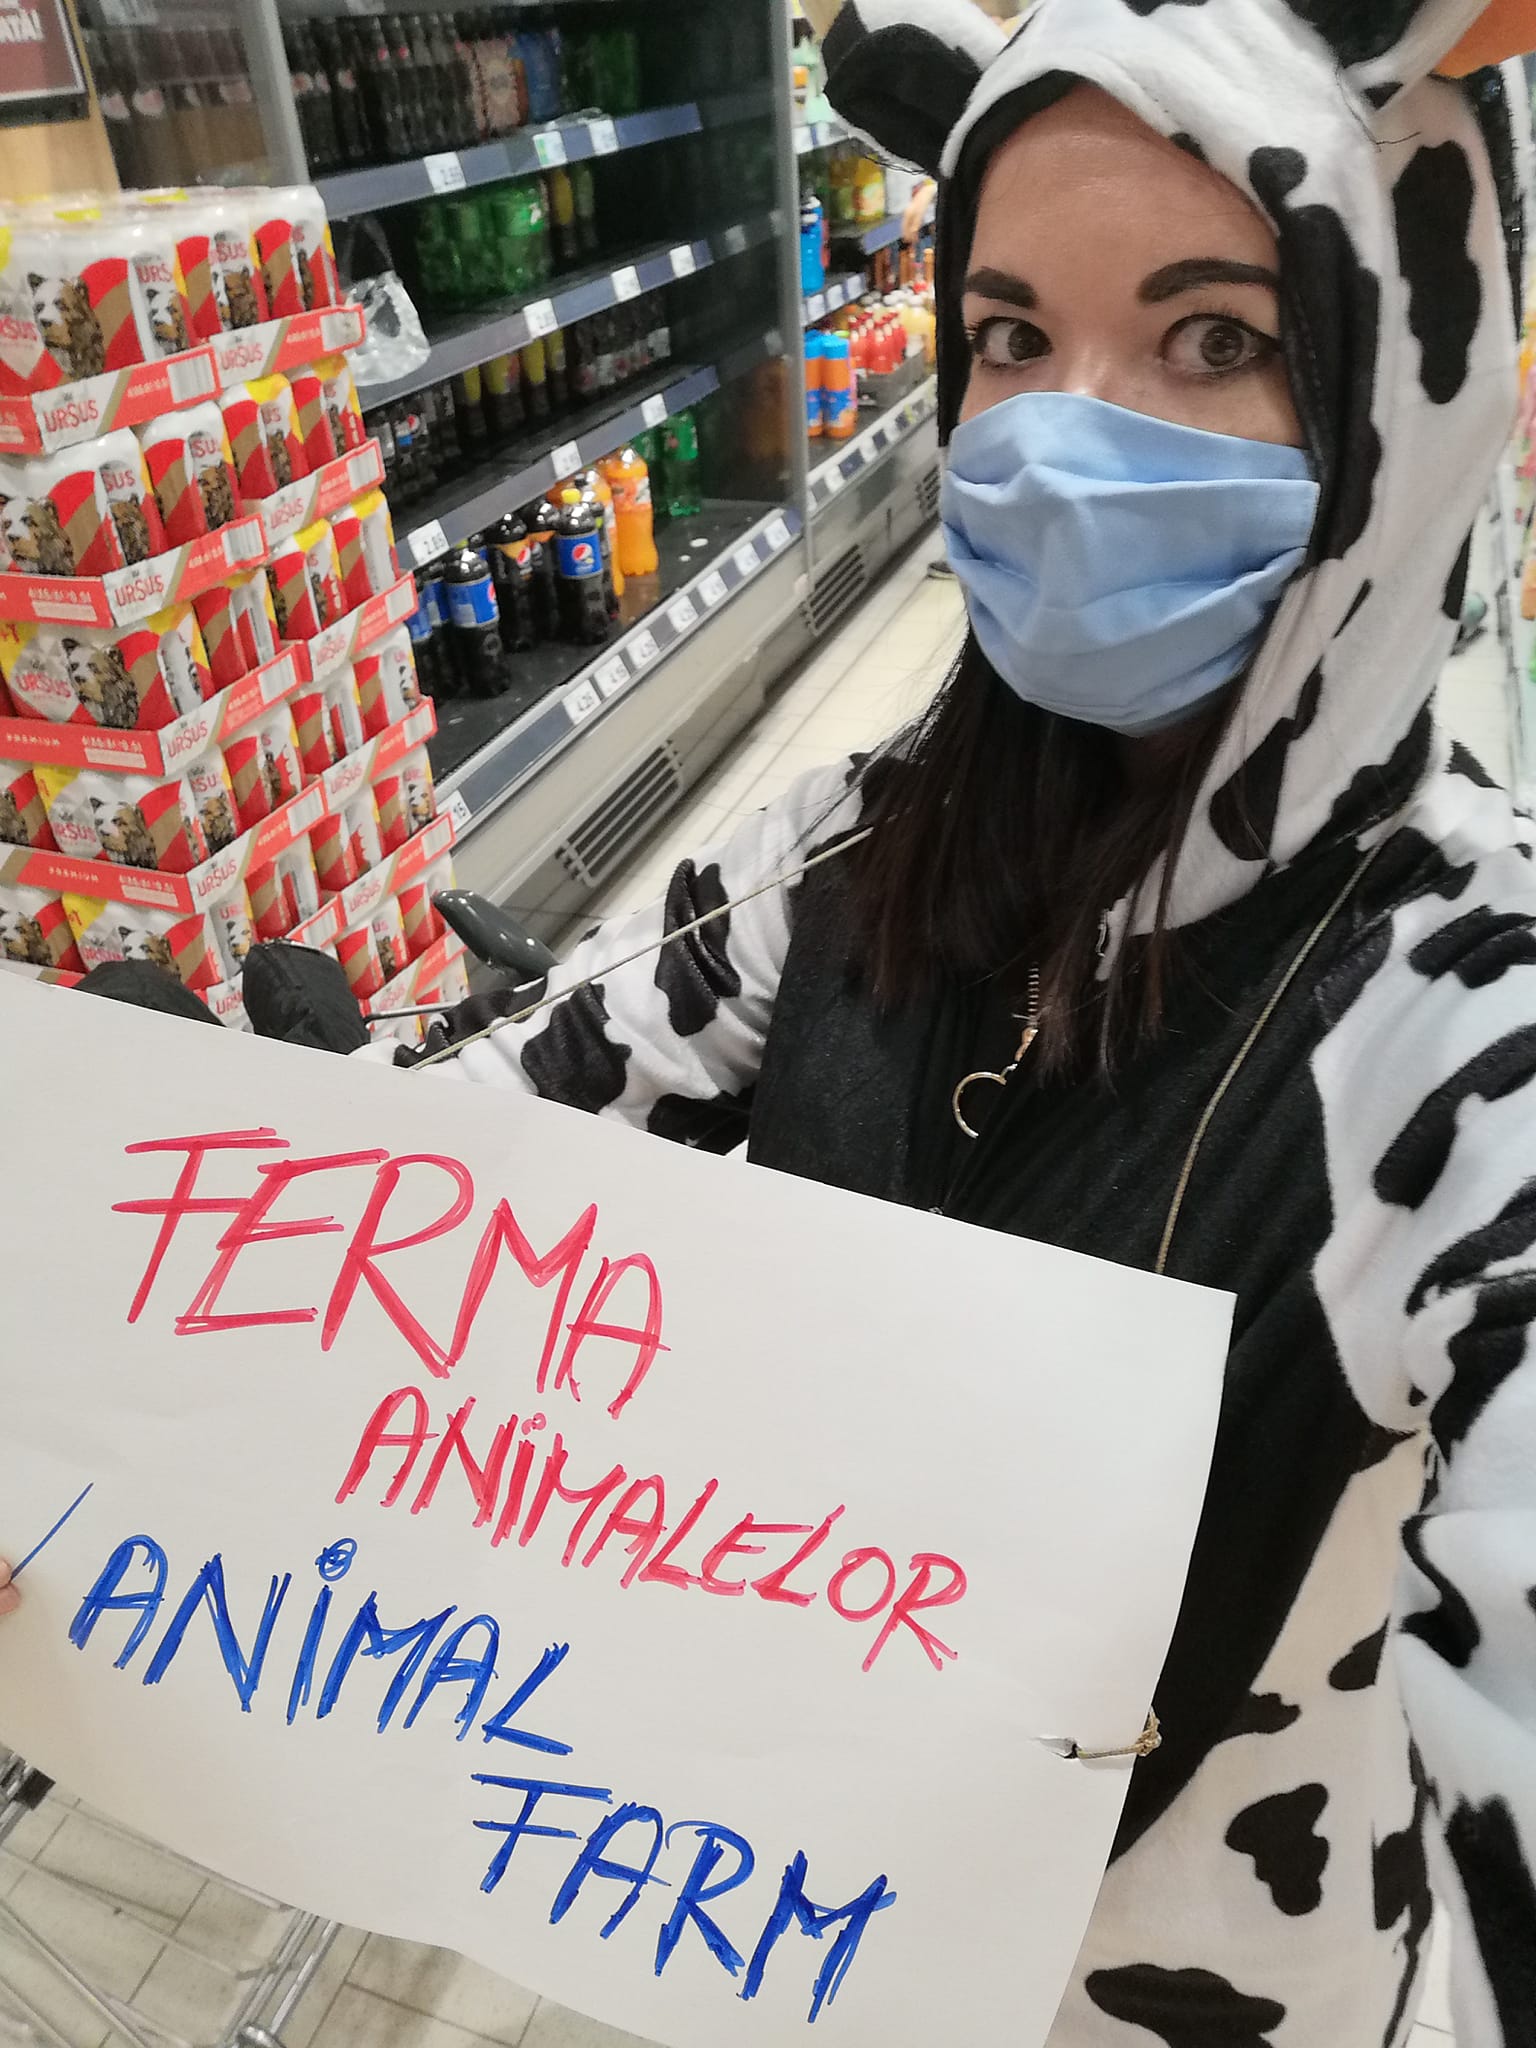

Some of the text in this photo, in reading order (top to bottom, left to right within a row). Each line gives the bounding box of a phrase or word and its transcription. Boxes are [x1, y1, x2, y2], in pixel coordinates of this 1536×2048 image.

[220, 343, 264, 370] URSUS
[43, 399, 99, 433] URSUS
[270, 498, 304, 530] URSUS
[114, 574, 165, 608] URSUS
[16, 672, 72, 699] URSUS
[6, 733, 61, 746] PREMIUM
[167, 720, 209, 759] URSUS
[330, 764, 363, 795] URSUS
[48, 867, 100, 882] PREMIUM
[197, 859, 238, 898] URSUS
[350, 879, 382, 912] URSUS
[112, 1126, 671, 1418] FERMA
[472, 1774, 898, 2024] FARM
